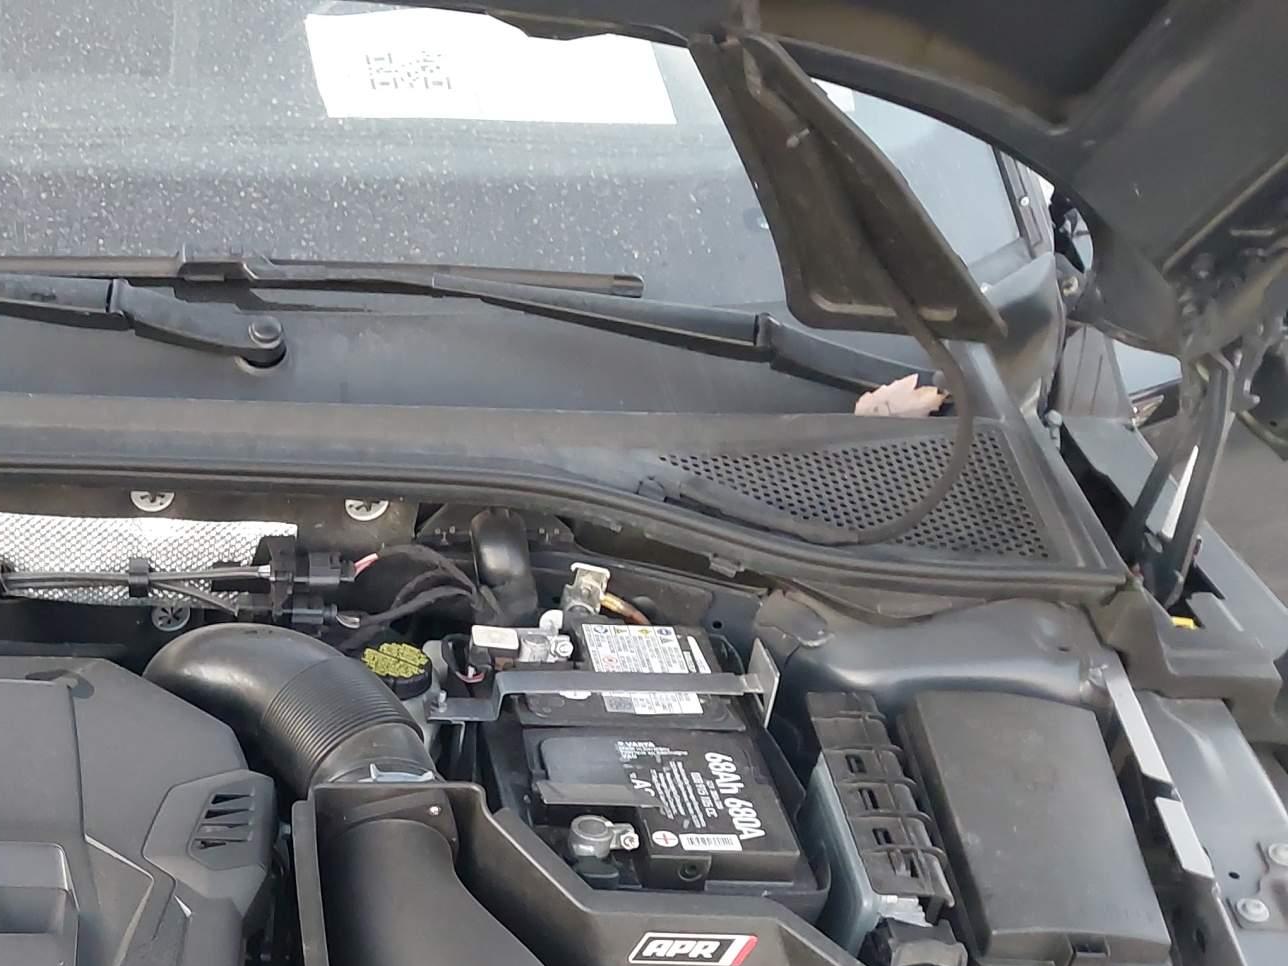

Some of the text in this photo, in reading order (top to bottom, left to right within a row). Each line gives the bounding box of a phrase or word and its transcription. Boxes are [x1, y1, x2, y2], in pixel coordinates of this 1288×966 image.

[705, 752, 744, 794] 68Ah
[724, 798, 766, 840] 680A
[642, 939, 720, 959] APR
